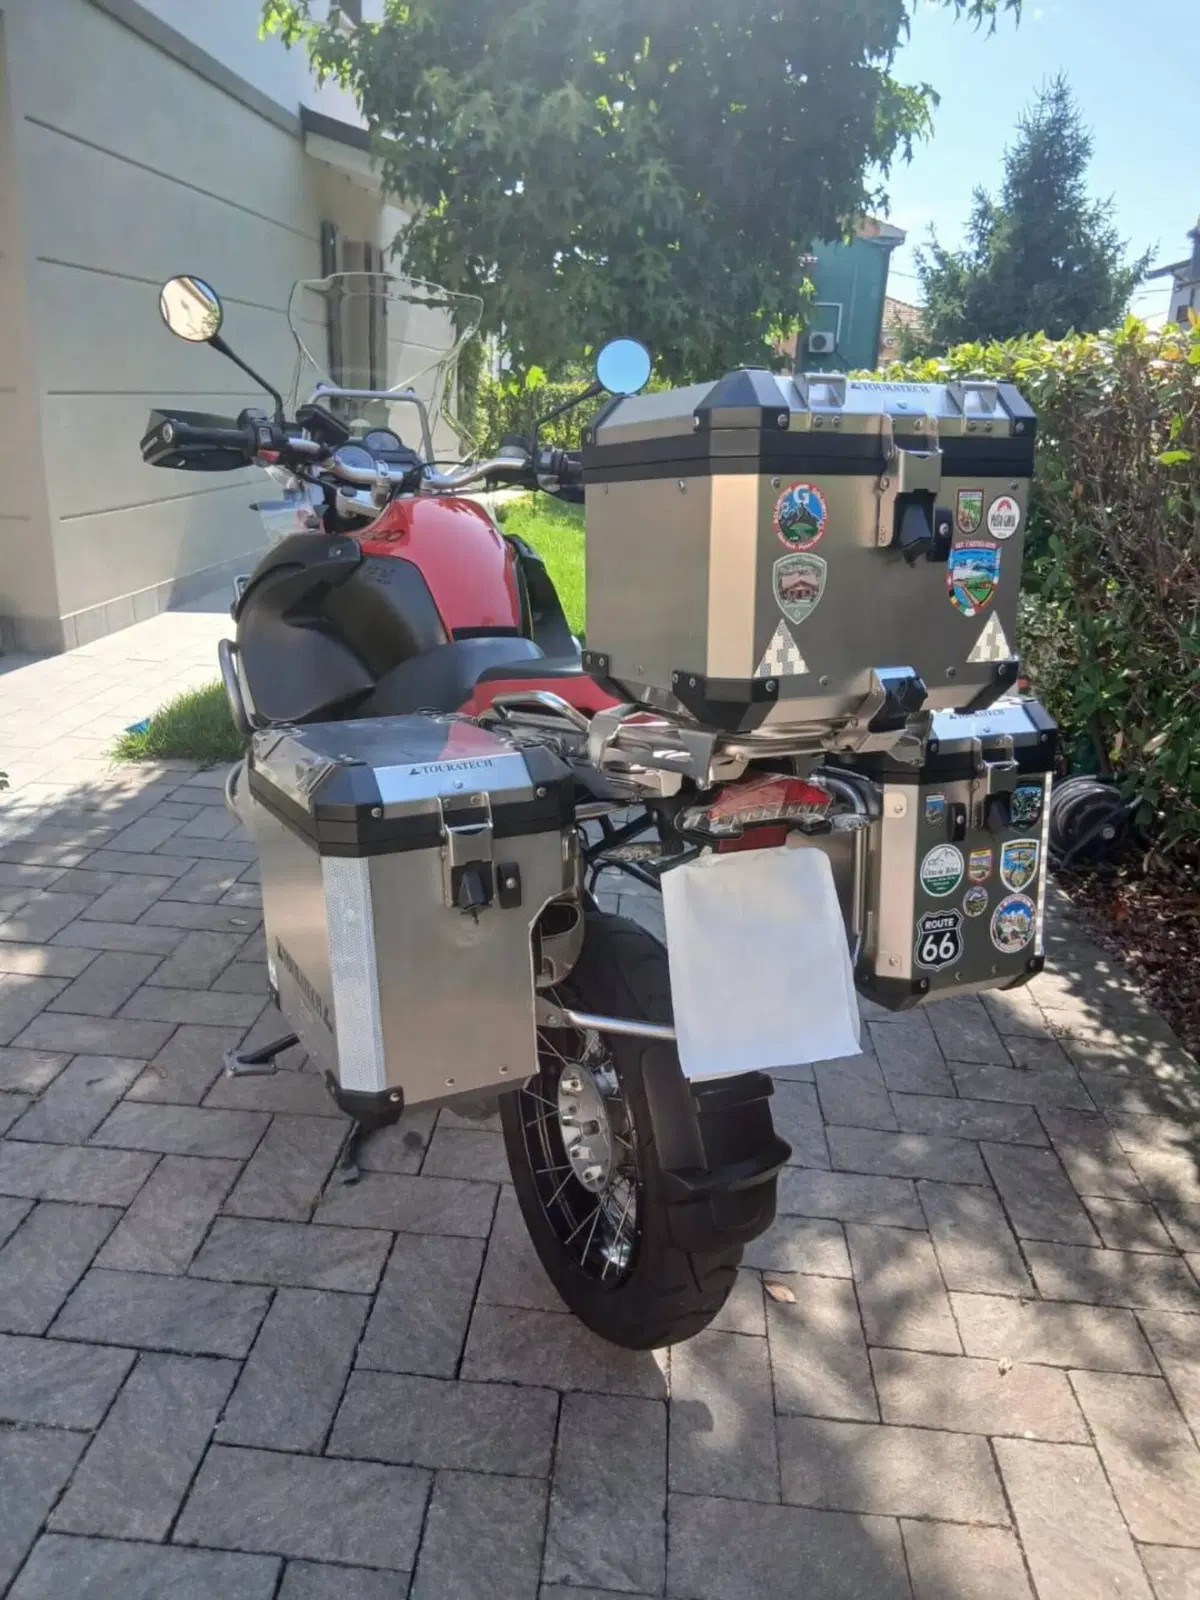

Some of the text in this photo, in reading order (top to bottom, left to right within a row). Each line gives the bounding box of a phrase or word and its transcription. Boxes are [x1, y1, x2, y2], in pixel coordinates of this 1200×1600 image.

[863, 382, 930, 393] TOURATECH
[422, 759, 493, 774] TOURATECH
[925, 918, 954, 930] ROUTE
[922, 932, 955, 962] 66
